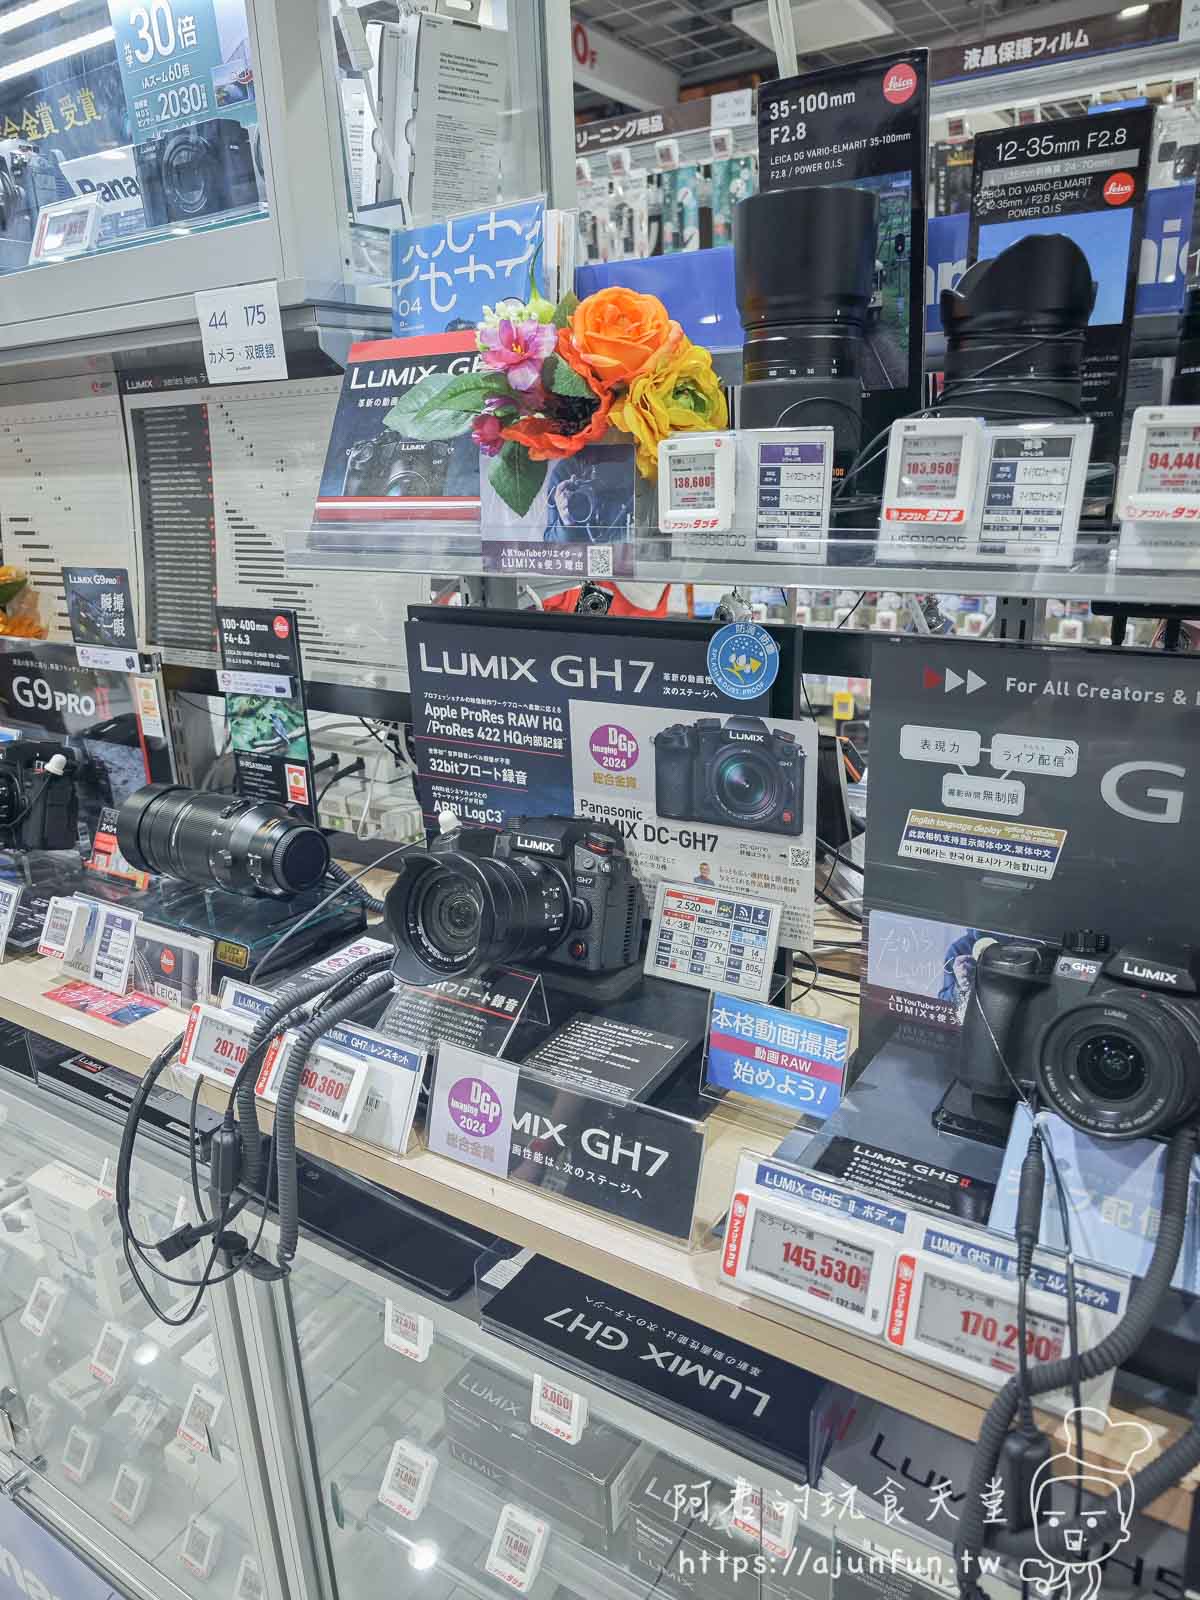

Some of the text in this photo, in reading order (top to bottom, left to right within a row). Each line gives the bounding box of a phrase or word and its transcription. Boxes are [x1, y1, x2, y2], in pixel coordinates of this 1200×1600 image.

[964, 28, 1089, 70] 液晶保護フィルム
[769, 91, 856, 121] 35-100mm
[770, 123, 807, 145] F2.8
[996, 128, 1127, 162] 12-35mm F2.8
[770, 132, 911, 166] LEICA DG VARIO-ELMARIT 35-100mm
[794, 162, 823, 176] POWER
[1008, 186, 1022, 197] DG
[1025, 176, 1093, 193] VARIO-ELMARIT
[1007, 205, 1042, 219] POWER
[208, 304, 267, 329] 44 175
[398, 297, 422, 317] 04
[208, 343, 276, 364] カメラ・双眼鏡
[350, 364, 439, 390] LUMIX
[419, 642, 656, 693] LUMIX GH7
[663, 687, 719, 699] 次のステージへ
[1006, 677, 1187, 705] For All Creators &
[424, 703, 563, 732] Apple ProRes RAW HQ
[426, 720, 474, 739] /ProRes
[477, 728, 501, 742] 422
[729, 730, 764, 743] LUMIX
[919, 738, 961, 754] 表現力
[602, 757, 627, 769] 2024
[1002, 750, 1066, 768] ライブ配信
[429, 758, 528, 786] 32bitフロート録音
[1100, 760, 1187, 824] G
[465, 804, 502, 823] LogC3
[580, 799, 643, 821] Panasonic
[516, 836, 555, 853] LUMIX
[643, 823, 718, 853] DC-GH7
[576, 876, 593, 885] GH7
[1071, 961, 1096, 974] GH5
[1122, 961, 1178, 984] LUMIX
[711, 1007, 847, 1062] 本格動画撮影
[753, 1046, 812, 1073] 動画RAW
[459, 1115, 487, 1135] 2024
[580, 1128, 670, 1177] GH7
[853, 1145, 909, 1168] LUMIX
[912, 1164, 960, 1184] GH5
[764, 1171, 806, 1194] LUMIX
[811, 1188, 843, 1208] GH5
[863, 1205, 897, 1226] ボディ
[930, 1235, 964, 1258] LUMIX
[968, 1247, 990, 1265] GH5
[783, 1241, 862, 1289] 145,530
[543, 1307, 771, 1417] LUMIX GH7
[457, 1372, 521, 1417] LUMIX
